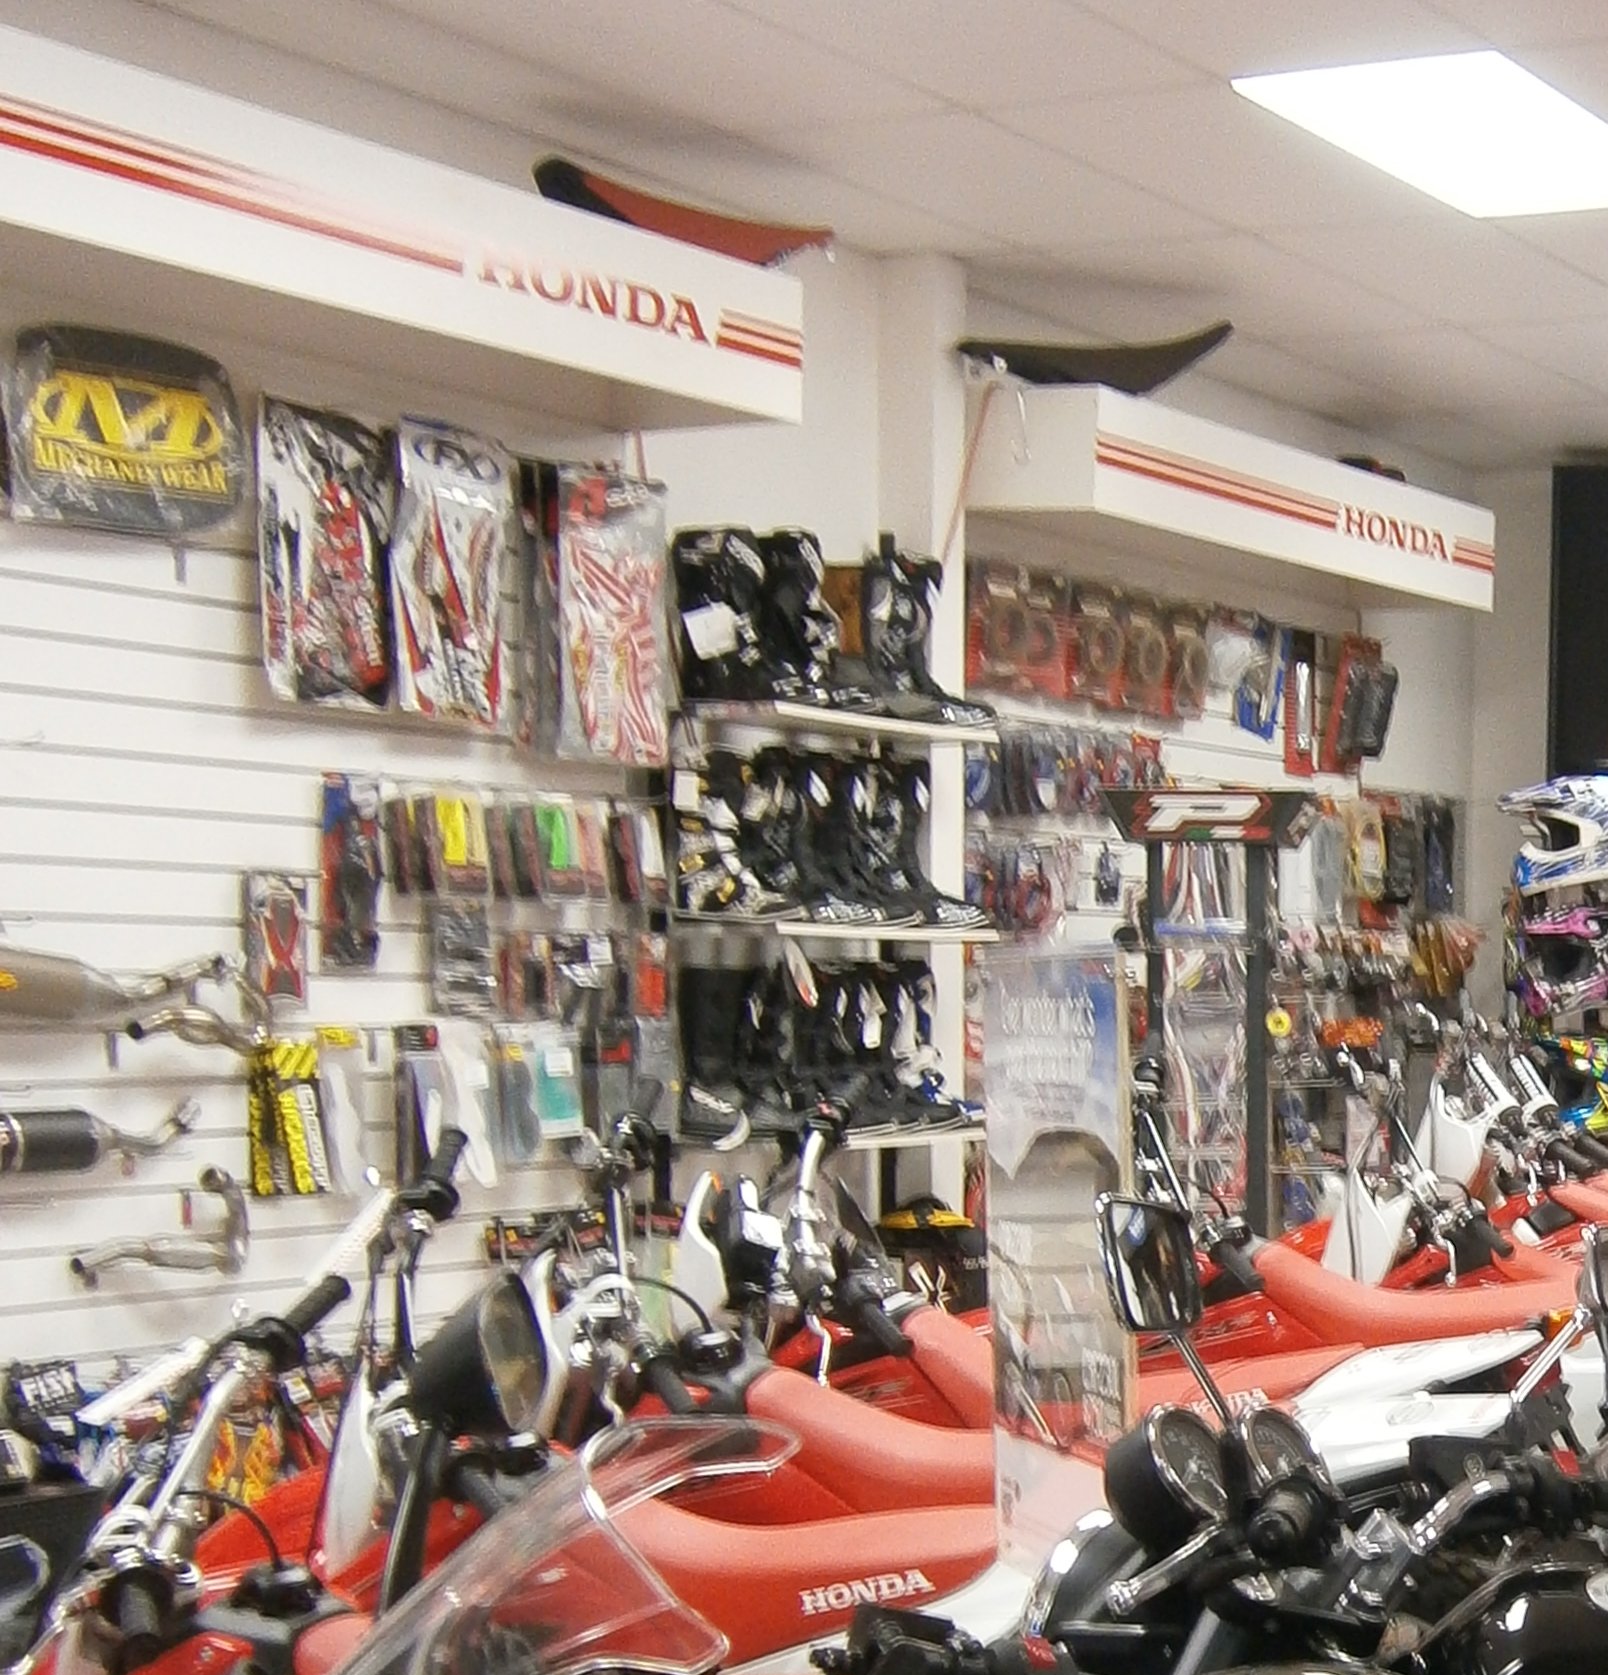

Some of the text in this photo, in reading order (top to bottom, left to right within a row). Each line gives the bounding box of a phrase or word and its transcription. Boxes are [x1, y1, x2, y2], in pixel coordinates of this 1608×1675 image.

[477, 244, 713, 346] HONDA
[1342, 502, 1451, 562] HONDA
[1189, 1387, 1273, 1417] HNDA
[799, 1568, 937, 1616] HONDA
